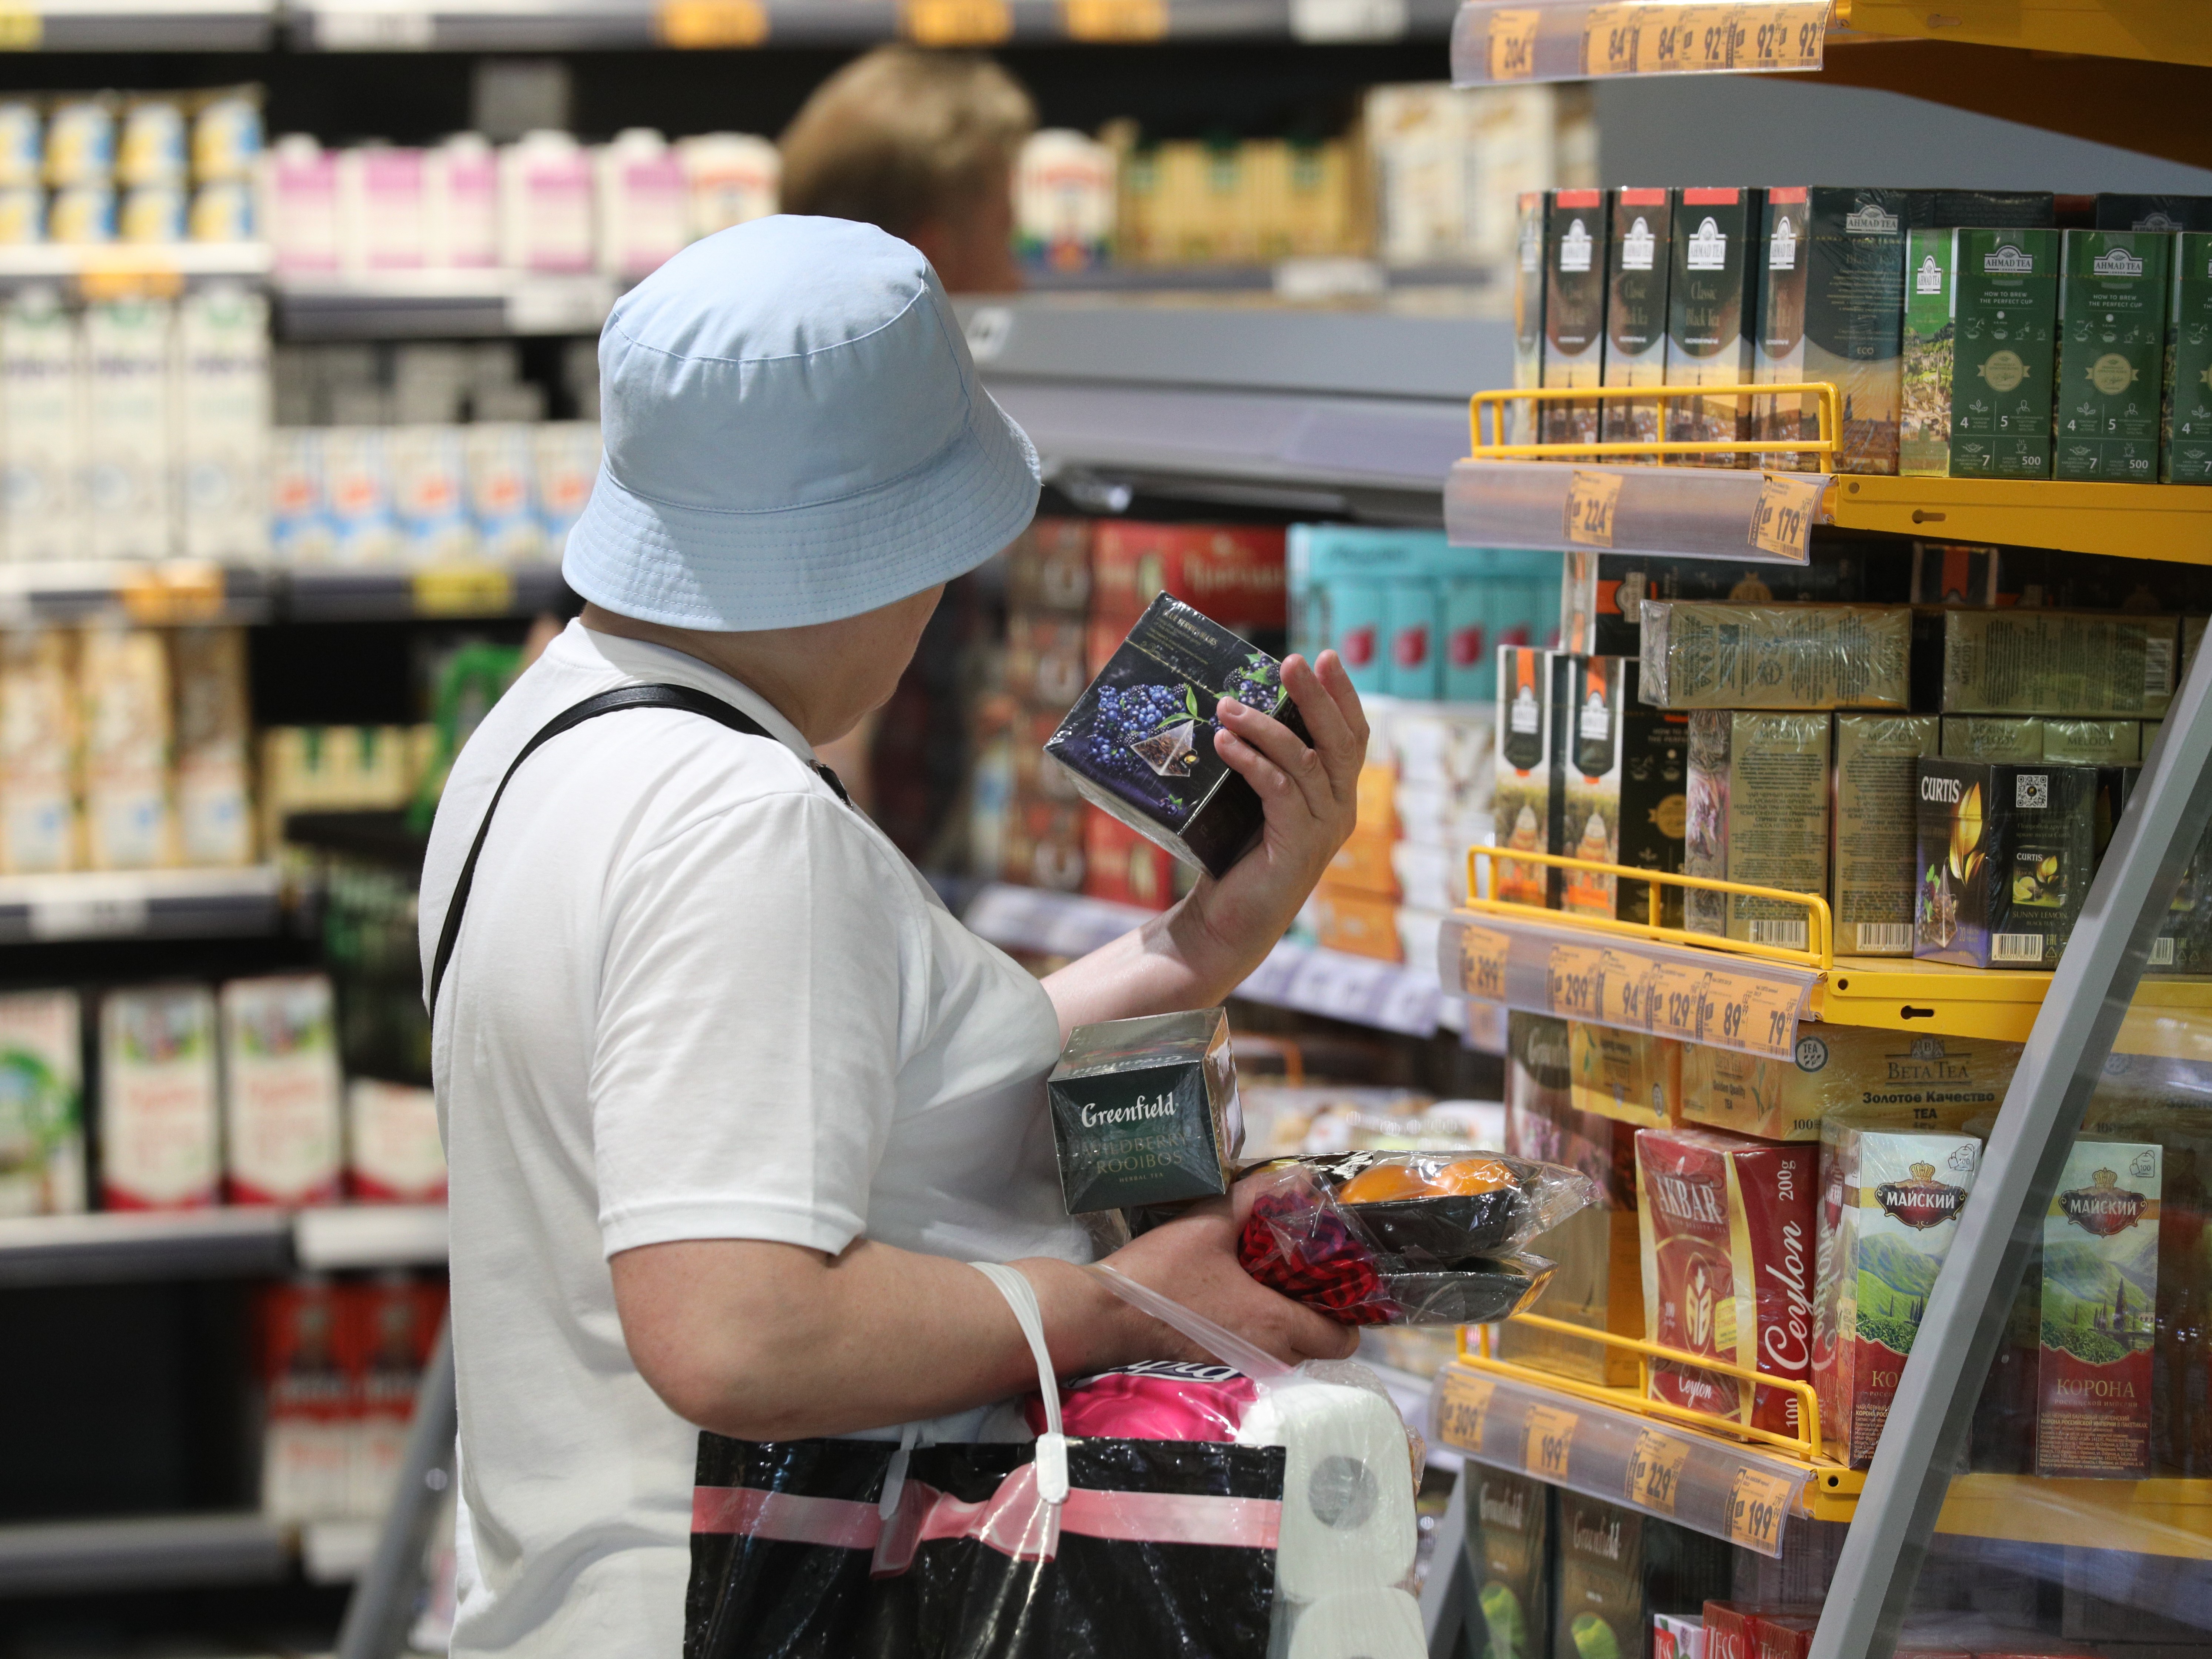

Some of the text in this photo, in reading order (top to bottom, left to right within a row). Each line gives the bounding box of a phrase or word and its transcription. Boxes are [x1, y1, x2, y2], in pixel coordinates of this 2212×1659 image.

[1608, 27, 1625, 61] 84
[1659, 26, 1676, 60] 84
[1705, 26, 1721, 60] 92
[1758, 24, 1774, 58] 92
[1799, 22, 1817, 57] 92
[1848, 218, 1896, 228] AHMAD TEA
[1689, 243, 1723, 257] AHMAD TEA
[1986, 259, 2031, 267] AHMAD TEA
[1918, 275, 1932, 285] AHMAD
[1856, 347, 1874, 355] ECO
[1960, 417, 1968, 428] 4
[2001, 416, 2008, 427] 5
[2067, 420, 2076, 431] 4
[2108, 418, 2116, 430] 5
[2182, 423, 2191, 434] 4
[1982, 455, 1990, 466] 7
[2022, 456, 2041, 465] 500
[2089, 458, 2098, 469] 7
[2129, 460, 2148, 469] 500
[2204, 461, 2212, 472] 7
[1584, 498, 1607, 533] 224
[1776, 506, 1800, 545] 179
[1867, 732, 1912, 741] MELODY
[2068, 736, 2112, 745] MELODY
[1921, 776, 1959, 804] CURTIS
[2017, 853, 2043, 861] CURTIS
[1567, 973, 1588, 1008] 299
[1623, 981, 1639, 1017] 94
[1669, 991, 1690, 1027] 129
[1724, 1002, 1741, 1038] 89
[1768, 1010, 1786, 1045] 79
[1804, 1044, 1818, 1054] TEA
[1729, 1083, 1745, 1100] Quality
[1863, 1091, 1995, 1104] Золотое Качество
[1081, 1091, 1176, 1128] Greenfield
[1913, 1108, 1938, 1119] TEA
[1793, 1119, 1813, 1130] 100
[1083, 1131, 1188, 1158] WILDBERRY
[1097, 1151, 1183, 1175] ROOIBOS
[1119, 1174, 1147, 1183] HERBAL
[1777, 1160, 1796, 1201] 200g
[1656, 1176, 1724, 1224] AKBAR
[1886, 1191, 1955, 1209] МАЙСКИЙ
[2070, 1198, 2137, 1216] МАЙСКИЙ
[1765, 1221, 1814, 1370] Ceylon
[1678, 1363, 1712, 1408] Ceylon
[2056, 1378, 2135, 1398] КОРОНА
[1786, 1398, 1798, 1428] 100
[1542, 1433, 1562, 1470] 199
[1647, 1462, 1672, 1501] 229
[1748, 1499, 1773, 1539] 199
[1706, 1625, 1737, 1659] TESS
